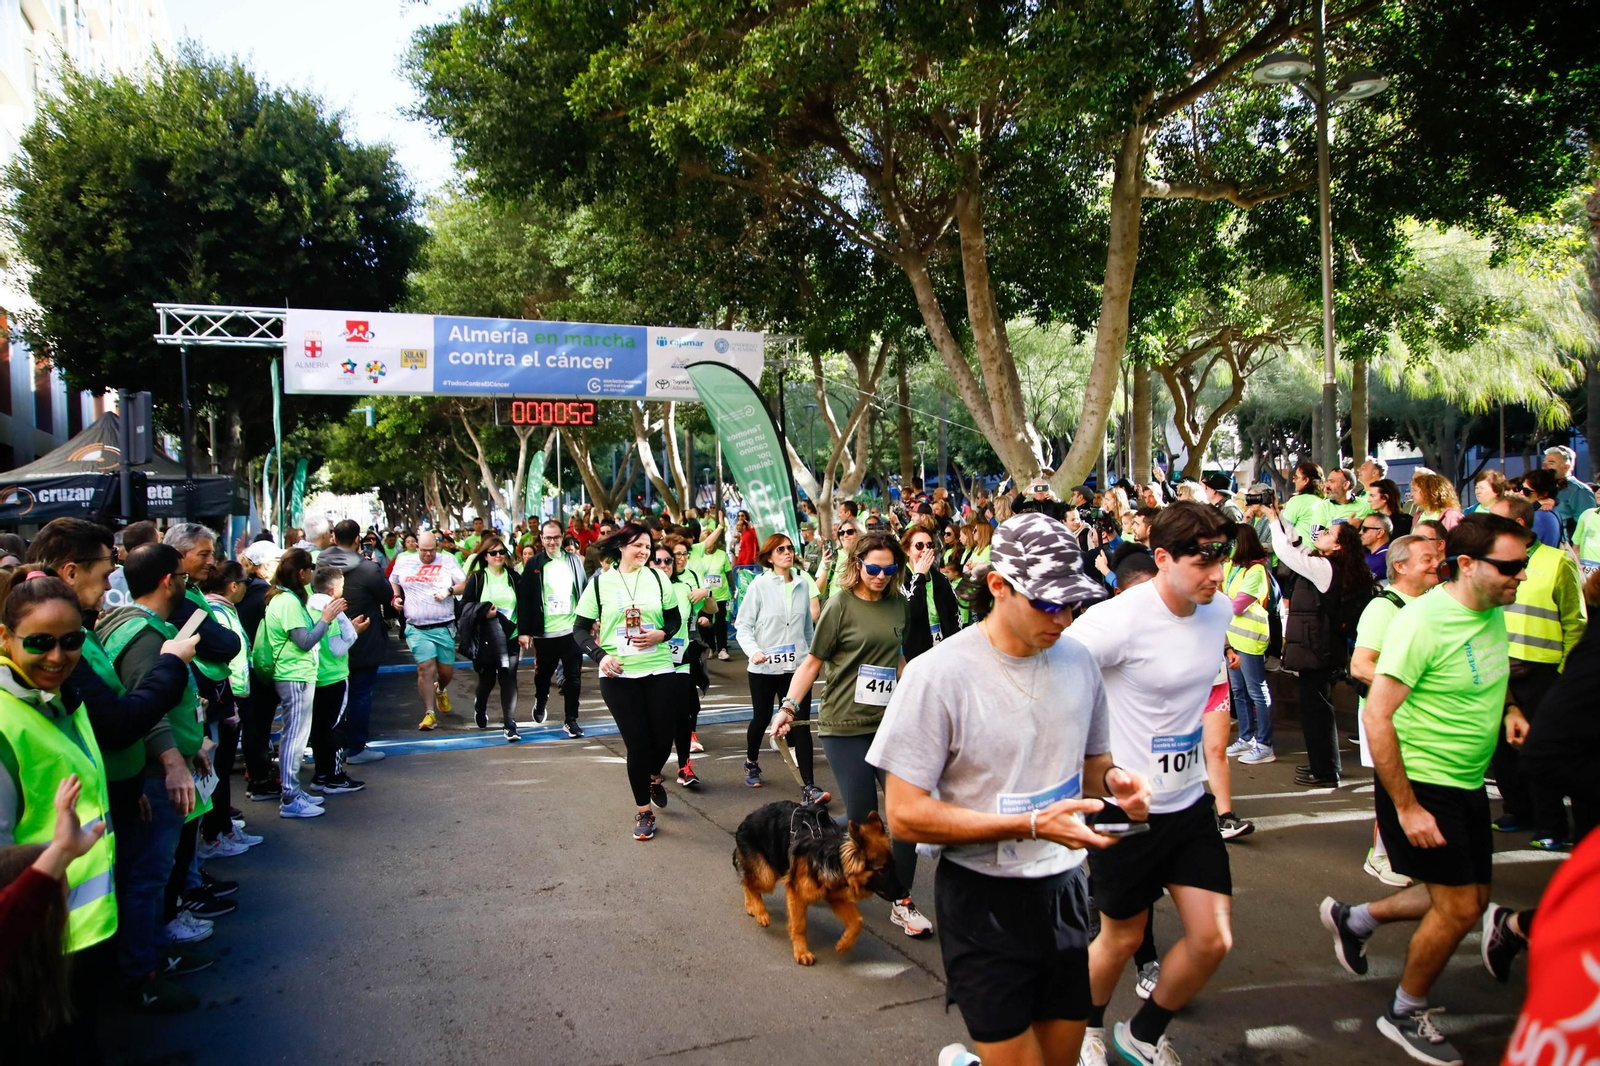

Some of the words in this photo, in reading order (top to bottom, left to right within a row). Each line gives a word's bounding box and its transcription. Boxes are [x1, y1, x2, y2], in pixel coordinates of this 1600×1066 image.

[448, 325, 528, 345] Almería
[535, 332, 558, 345] en
[564, 332, 636, 349] marcha
[669, 338, 704, 348] cajamar
[294, 361, 329, 369] ALMERÍA
[448, 350, 515, 367] contra
[521, 351, 541, 367] el
[545, 352, 613, 370] cáncer
[442, 380, 510, 388] #TodosContraElCáncer
[38, 486, 95, 503] cruzan
[147, 484, 173, 499] eta
[415, 564, 442, 576] GO
[766, 652, 796, 664] 1515
[865, 679, 893, 694] 414
[1158, 745, 1199, 773] 1071
[1003, 797, 1031, 805] Almería
[1035, 797, 1055, 808] cáncer
